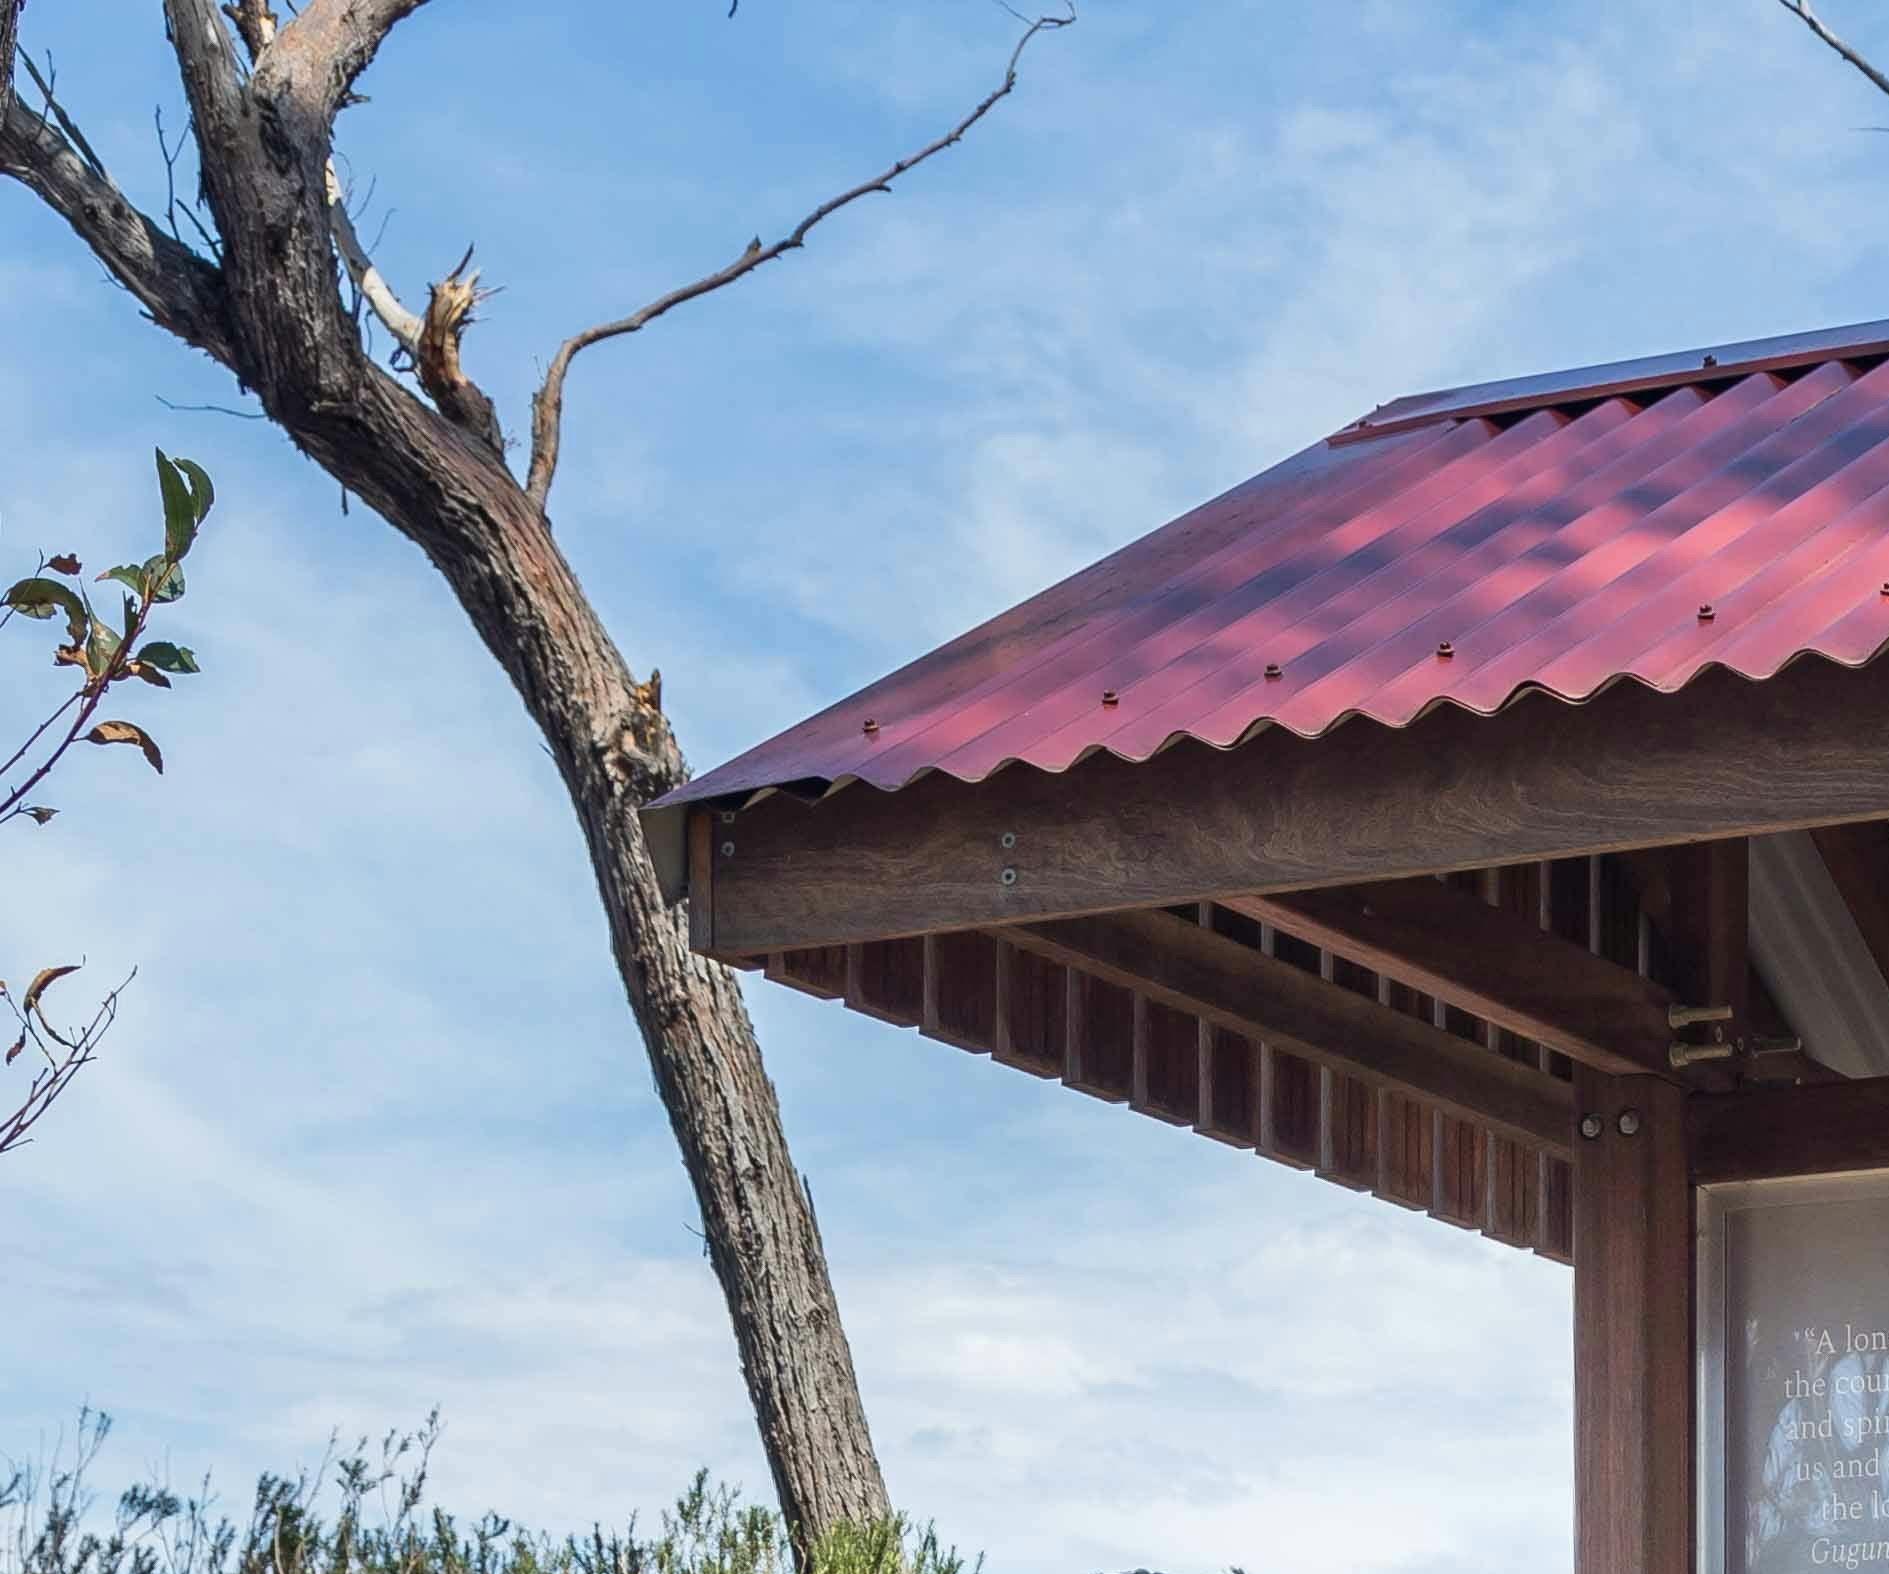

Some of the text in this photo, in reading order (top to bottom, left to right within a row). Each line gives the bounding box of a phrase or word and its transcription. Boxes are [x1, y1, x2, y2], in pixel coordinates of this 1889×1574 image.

[1784, 1368, 1826, 1399] the
[1784, 1408, 1832, 1440] and
[1794, 1460, 1824, 1481] us
[1832, 1447, 1880, 1479] and
[1822, 1491, 1863, 1521] the
